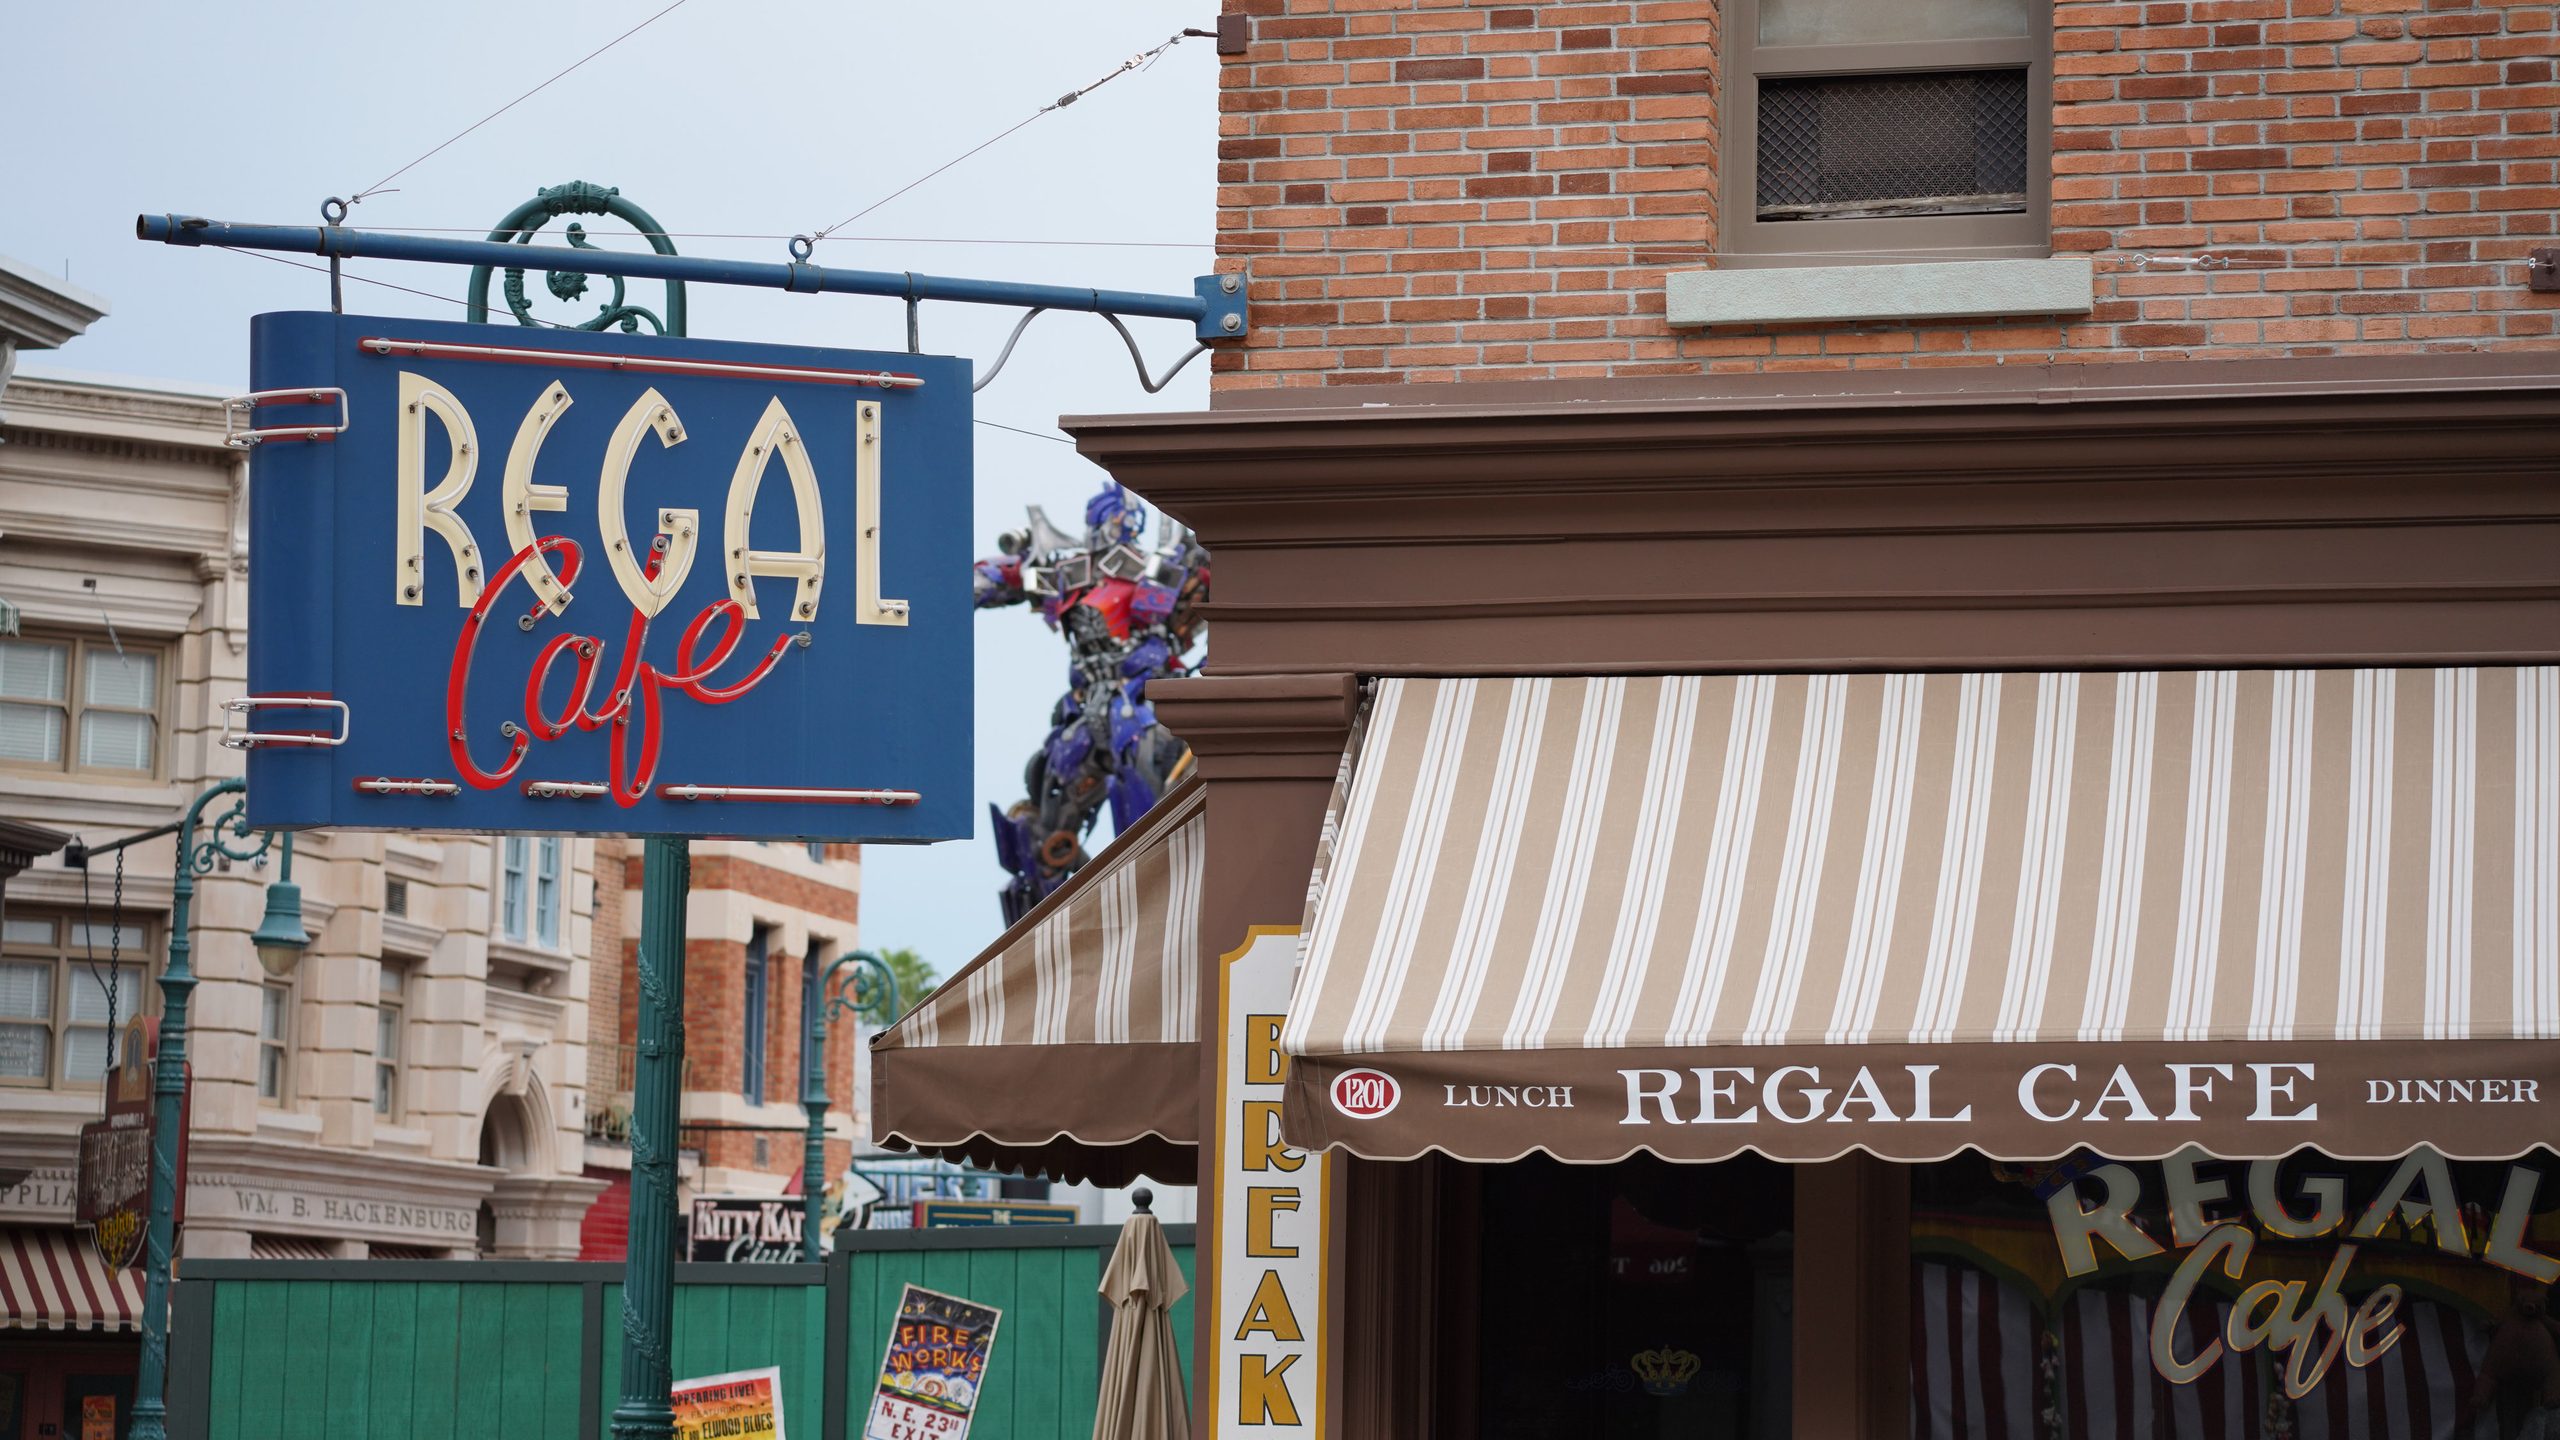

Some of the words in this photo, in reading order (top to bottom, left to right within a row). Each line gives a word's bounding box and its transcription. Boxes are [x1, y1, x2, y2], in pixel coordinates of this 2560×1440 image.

[396, 370, 909, 626] REGAL
[446, 535, 808, 808] Cafe
[1343, 1077, 1386, 1110] 1201
[1443, 1083, 1574, 1108] LUNCH
[1617, 1064, 1971, 1125] REGAL
[2016, 1063, 2318, 1122] CAFE
[2366, 1078, 2541, 1104] DINNER
[235, 1190, 279, 1215] WM.
[292, 1197, 311, 1218] B.
[324, 1199, 472, 1232] HACKENBURG
[1234, 1014, 1306, 1426] BREAK
[2048, 1145, 2560, 1285] REGAL
[900, 1325, 971, 1348] FIRE
[2150, 1222, 2407, 1399] Cafe
[891, 1348, 983, 1374] WORKS
[729, 1383, 755, 1399] LIVE!
[881, 1401, 897, 1419] N.
[702, 1417, 741, 1440] ELWOOD
[743, 1412, 773, 1434] BLUES
